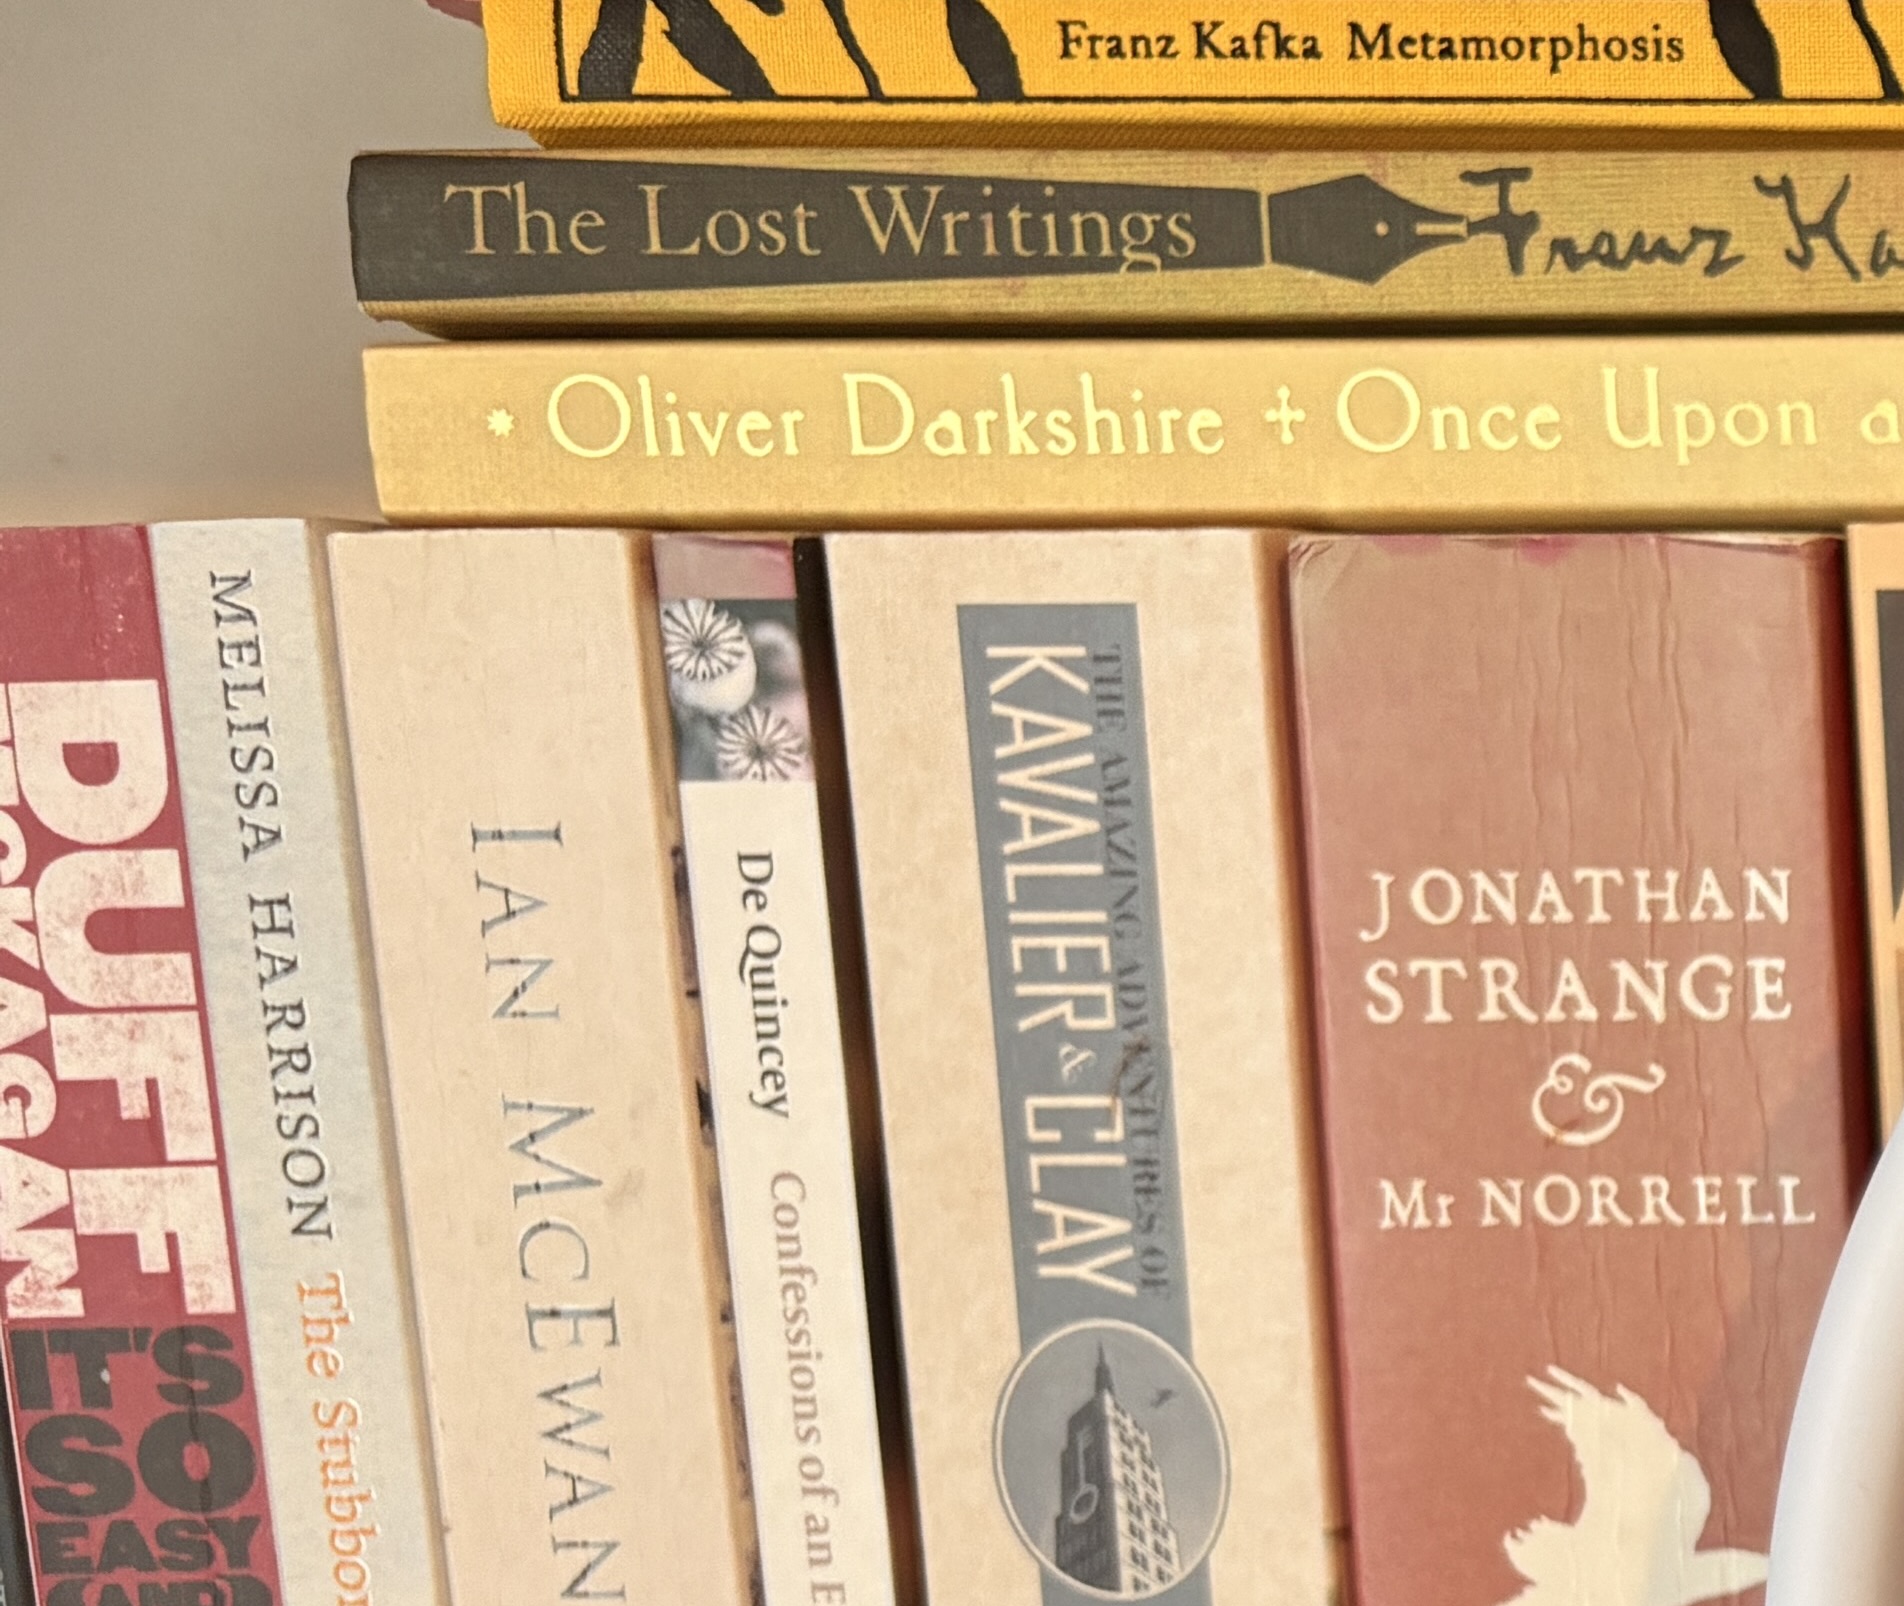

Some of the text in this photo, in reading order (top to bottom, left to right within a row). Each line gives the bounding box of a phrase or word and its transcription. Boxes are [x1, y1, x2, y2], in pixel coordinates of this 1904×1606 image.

[1059, 21, 1685, 74] Franz Kafka Metamorphosis
[443, 184, 1197, 275] The Lost Writings
[1459, 166, 1744, 278] Franz
[547, 371, 804, 460] Oliver
[843, 371, 1226, 460] Darkshire
[1336, 367, 1563, 455] Once
[1600, 363, 1818, 466] Upon
[1858, 398, 1903, 445] a
[208, 568, 334, 1242] MELISSA HARRISON
[470, 820, 565, 1022] IAN
[1360, 866, 1793, 942] JONATHAN
[8, 679, 236, 1315] DUFF
[736, 850, 791, 1120] De Quincey
[985, 645, 1138, 1299] KAVALIER & CLAY
[1092, 643, 1171, 1299] THE AMAZING ADVENTURES OF
[1364, 954, 1793, 1025] STRANGE
[1532, 1052, 1667, 1146] &
[1380, 1174, 1817, 1230] Mr NORRELL
[297, 1269, 354, 1380] The
[771, 1169, 822, 1446] Confessions
[8, 1325, 246, 1412] IT'S
[24, 1409, 257, 1518] SO
[799, 1454, 839, 1508] of
[36, 1515, 262, 1576] EASY
[804, 1512, 836, 1569] an
